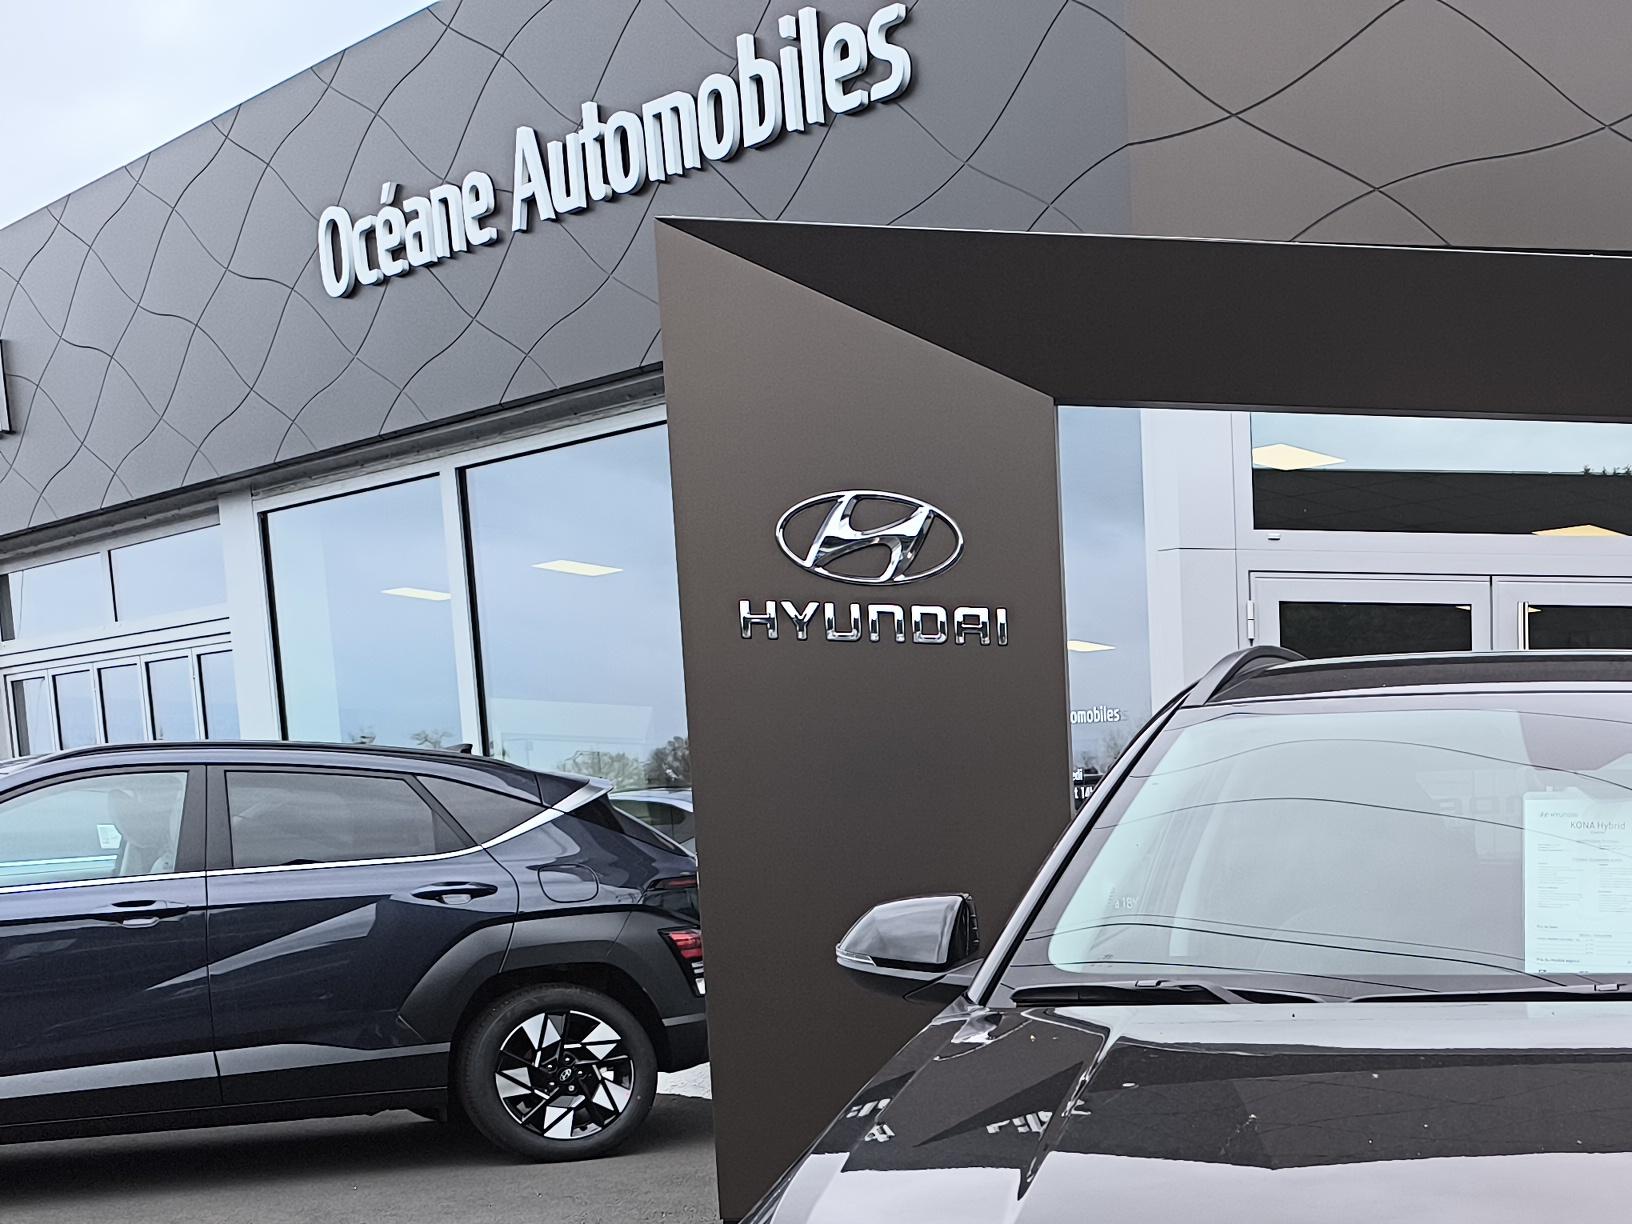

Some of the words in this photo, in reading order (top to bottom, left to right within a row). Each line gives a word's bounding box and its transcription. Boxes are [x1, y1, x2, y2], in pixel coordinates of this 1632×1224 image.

[318, 170, 499, 298] Océane
[511, 2, 912, 232] Automobiles
[739, 599, 1008, 646] HYUNDAI
[1570, 820, 1595, 829] KONA
[1597, 820, 1626, 832] Hybrid
